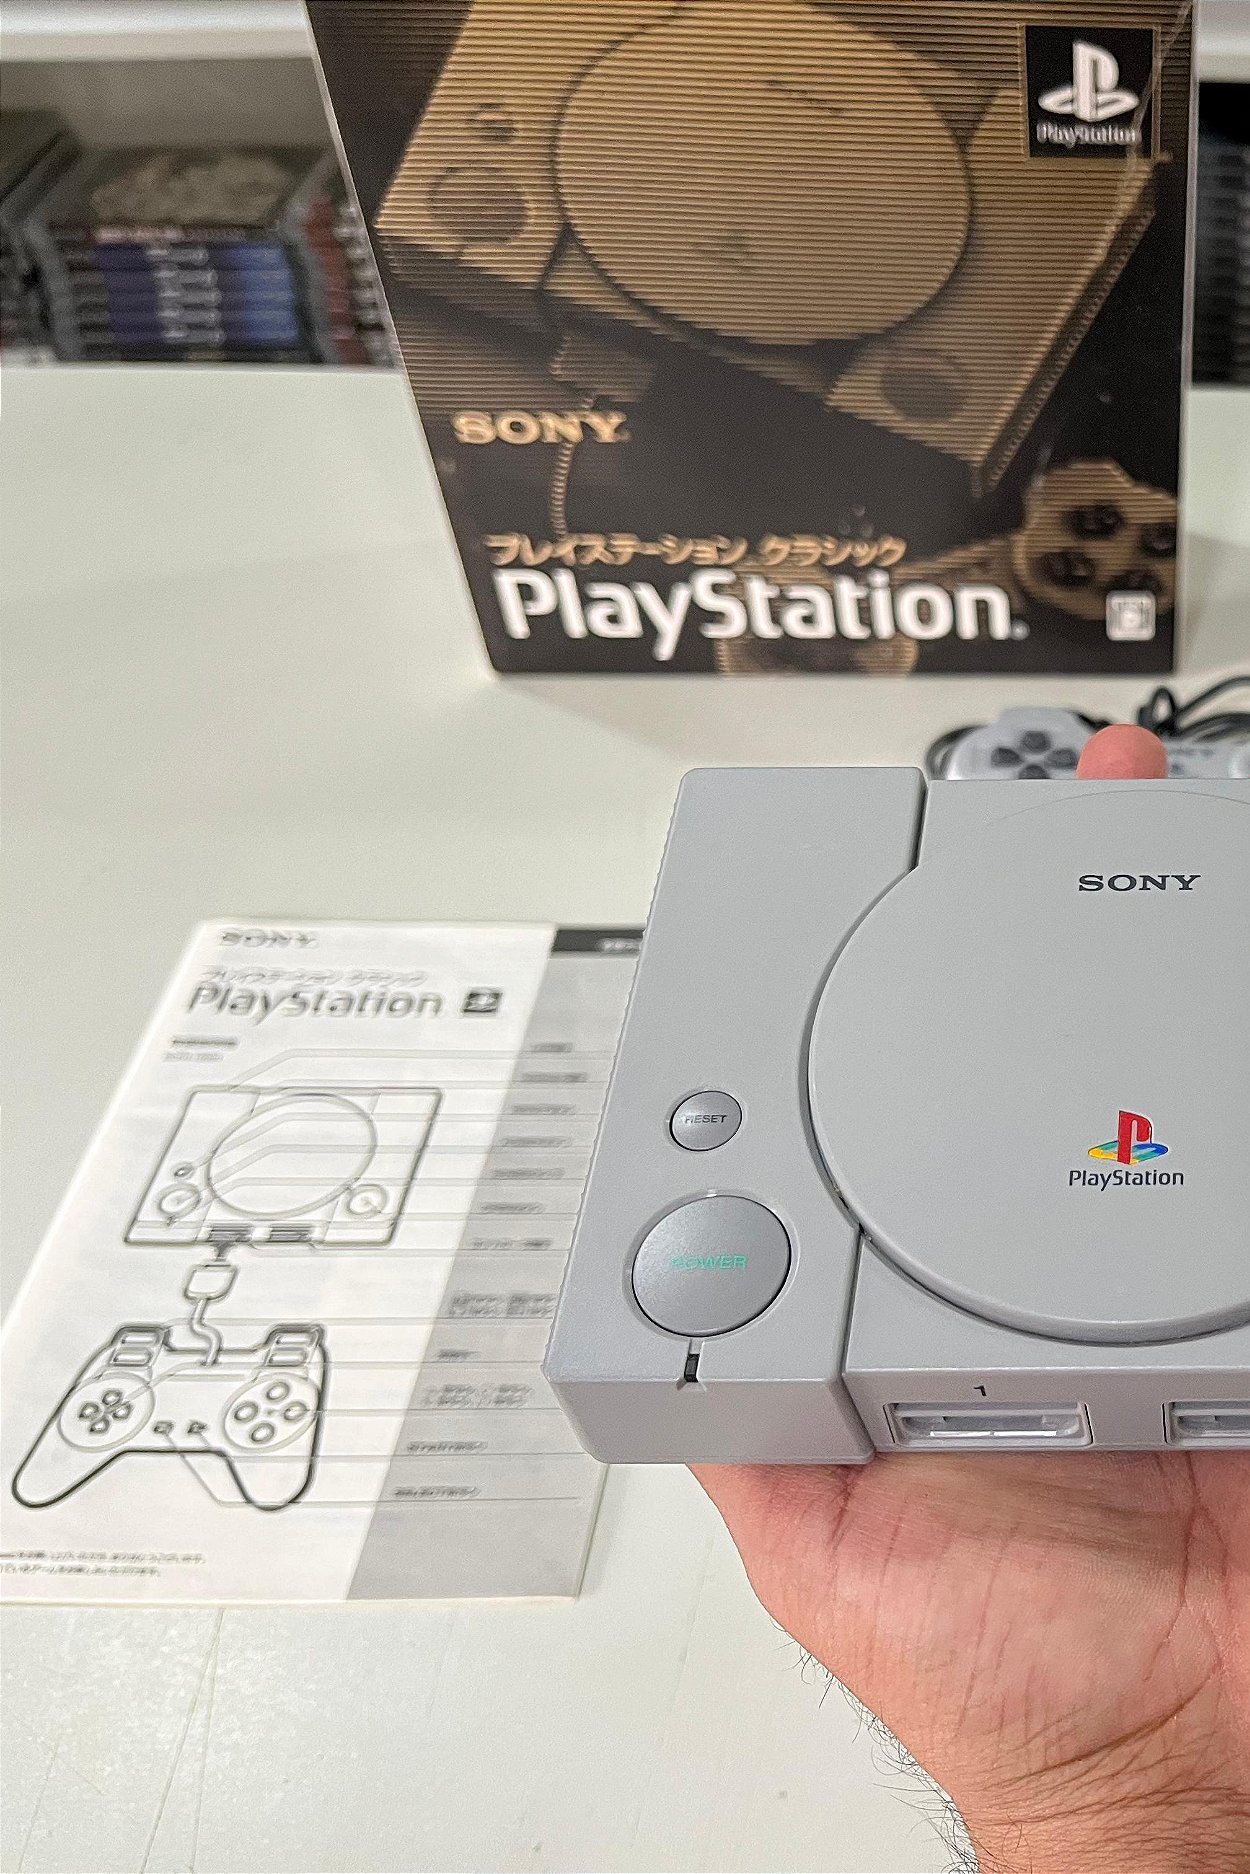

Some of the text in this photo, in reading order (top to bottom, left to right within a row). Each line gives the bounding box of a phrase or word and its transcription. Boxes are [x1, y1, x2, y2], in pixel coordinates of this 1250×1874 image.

[452, 411, 627, 445] SONY
[493, 567, 1013, 661] PlayStation
[1078, 874, 1201, 891] SONY
[187, 981, 443, 1025] PlayStation
[685, 1114, 728, 1125] RESET
[1069, 1169, 1184, 1192] PlayStation
[670, 1255, 748, 1270] POWER
[973, 1385, 987, 1396] 1
